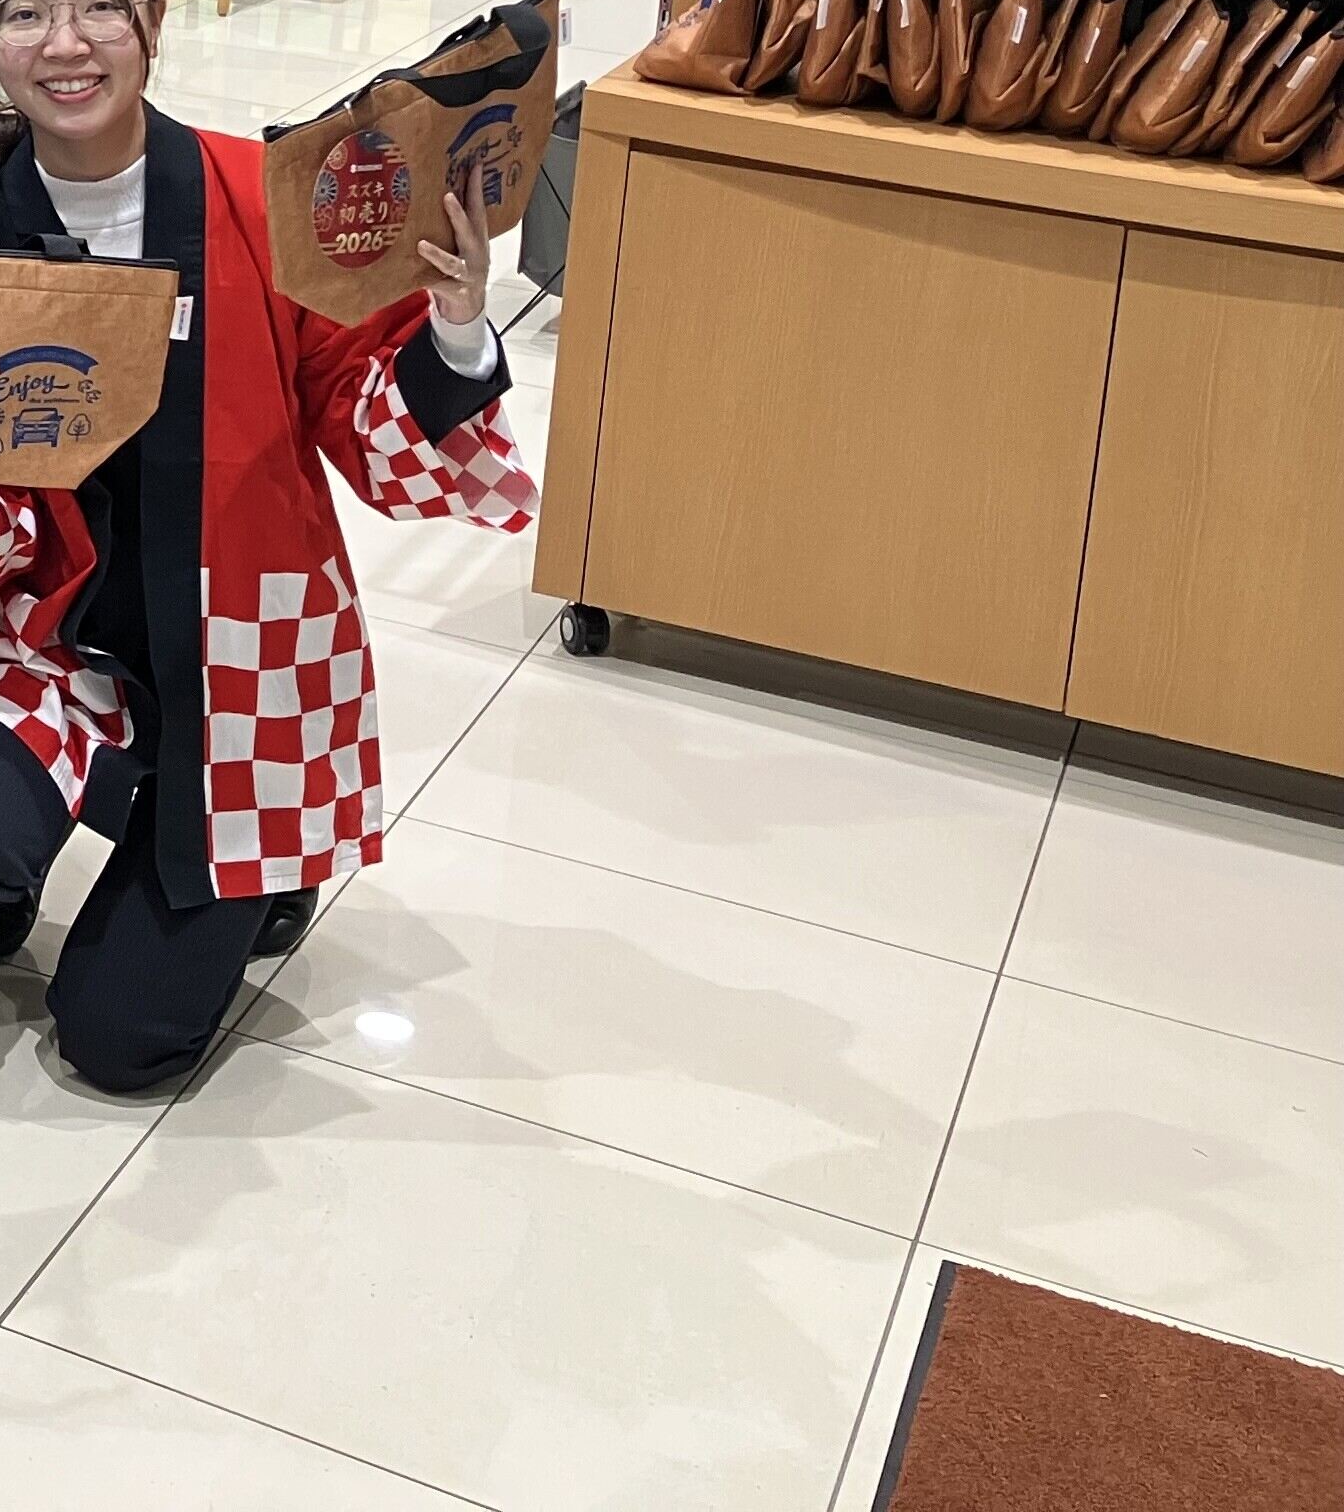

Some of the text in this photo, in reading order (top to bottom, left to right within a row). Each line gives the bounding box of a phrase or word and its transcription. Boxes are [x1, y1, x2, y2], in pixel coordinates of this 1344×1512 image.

[347, 181, 384, 198] スズキ
[339, 200, 388, 225] 初売り
[335, 230, 384, 254] 2026
